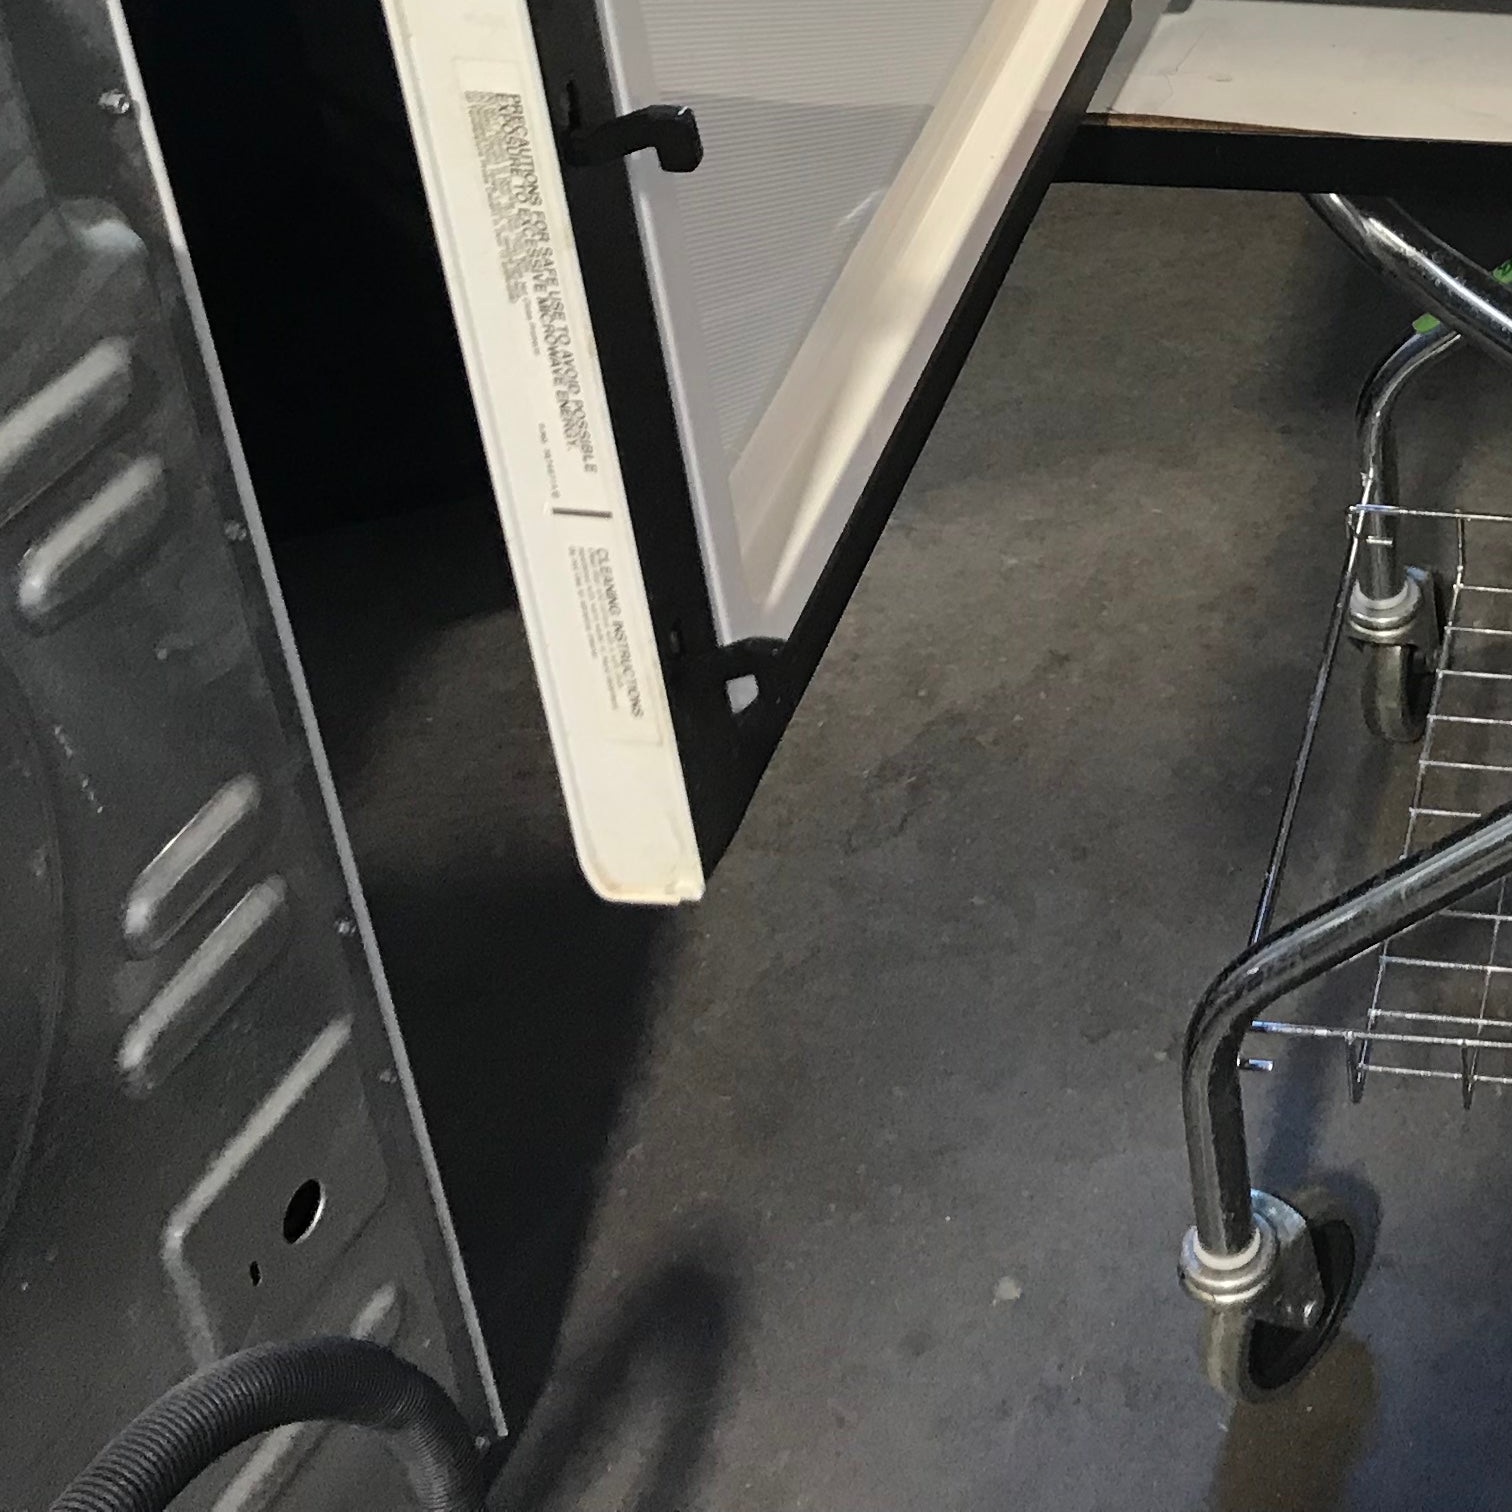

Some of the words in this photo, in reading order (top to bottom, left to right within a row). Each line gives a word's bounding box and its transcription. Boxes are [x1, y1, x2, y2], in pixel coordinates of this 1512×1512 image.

[507, 93, 543, 204] PRECAUTIONS
[532, 211, 550, 241] FOR
[539, 246, 559, 287] SAFE
[548, 291, 566, 319] USE
[536, 297, 566, 385] MICROWAVE
[560, 351, 581, 393] AVOID
[570, 400, 597, 472] POSSIBLE
[595, 548, 621, 614] CLEANING
[611, 621, 644, 717] INSTRUCTIONS
